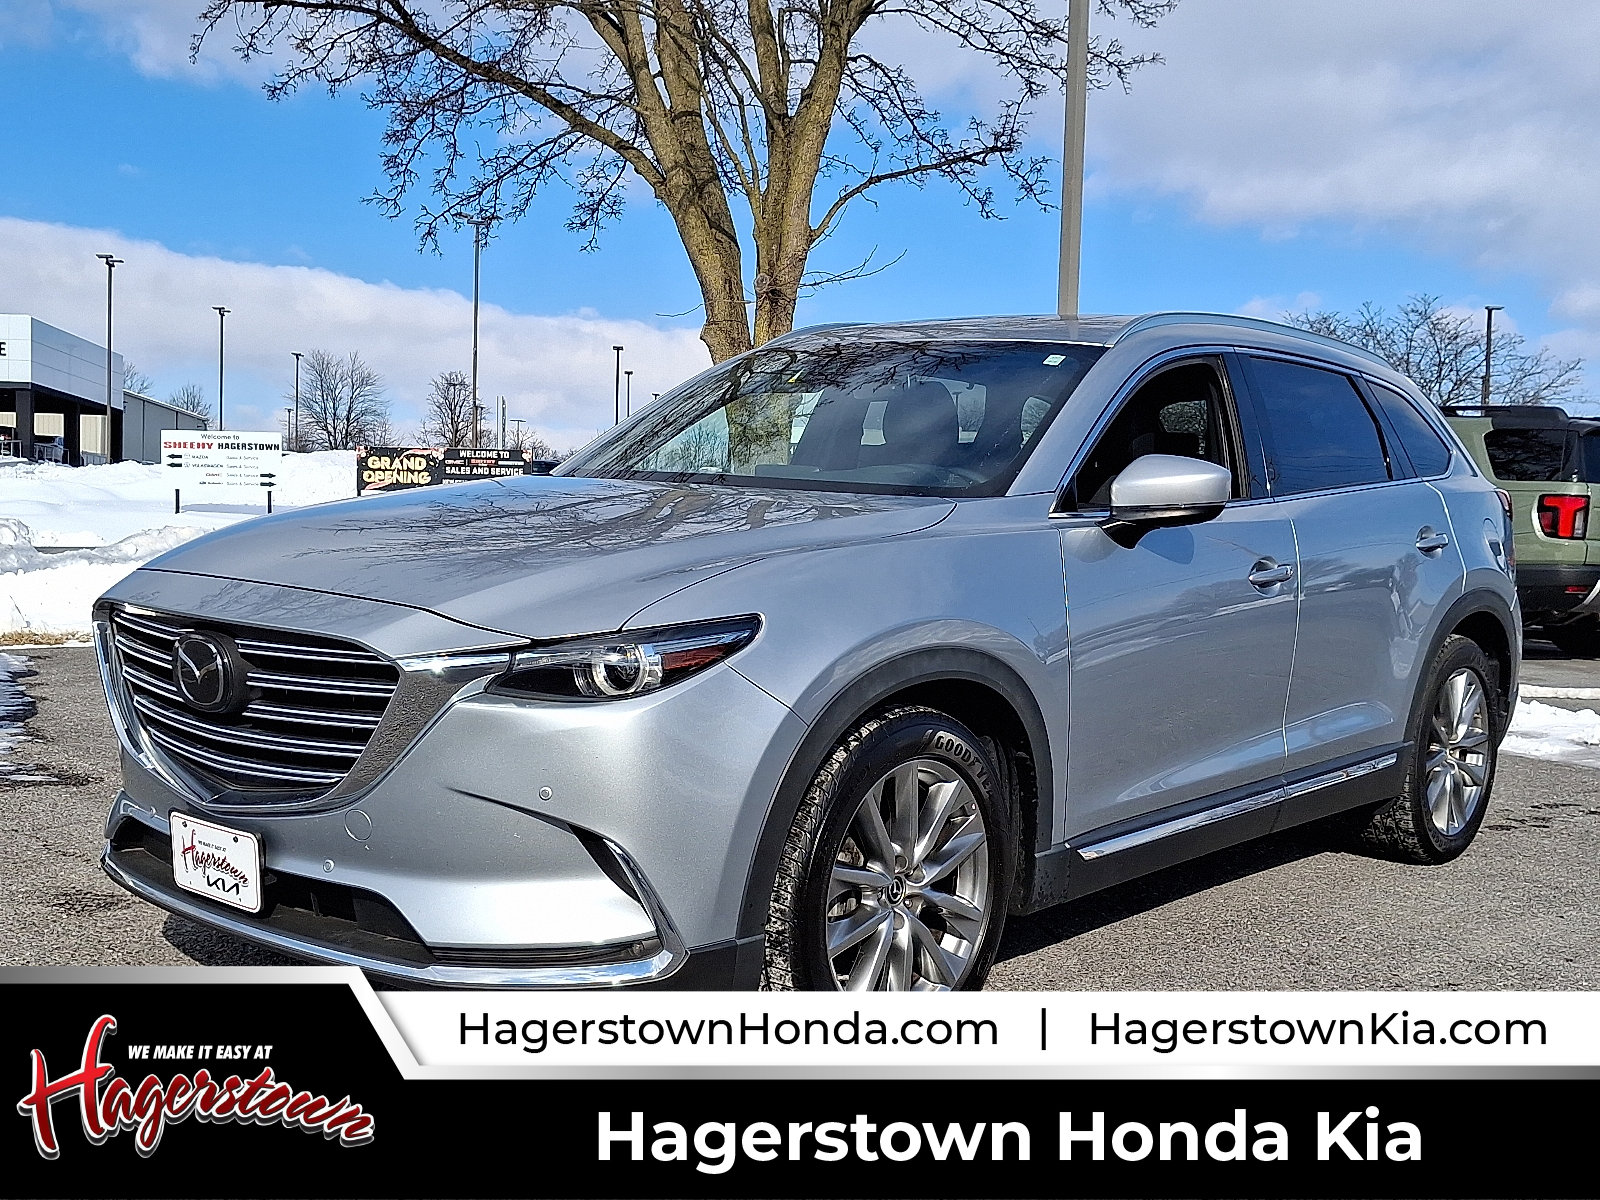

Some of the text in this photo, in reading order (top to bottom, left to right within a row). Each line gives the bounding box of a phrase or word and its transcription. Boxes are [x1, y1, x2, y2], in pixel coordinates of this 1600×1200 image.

[163, 441, 280, 451] SHEEHY HAGERSTOWN
[460, 450, 510, 459] WELCOME TO
[367, 456, 427, 471] GRAND
[445, 466, 524, 476] SALES AND SERVICE
[362, 470, 432, 485] OPENING
[181, 829, 249, 887] Hagerstown
